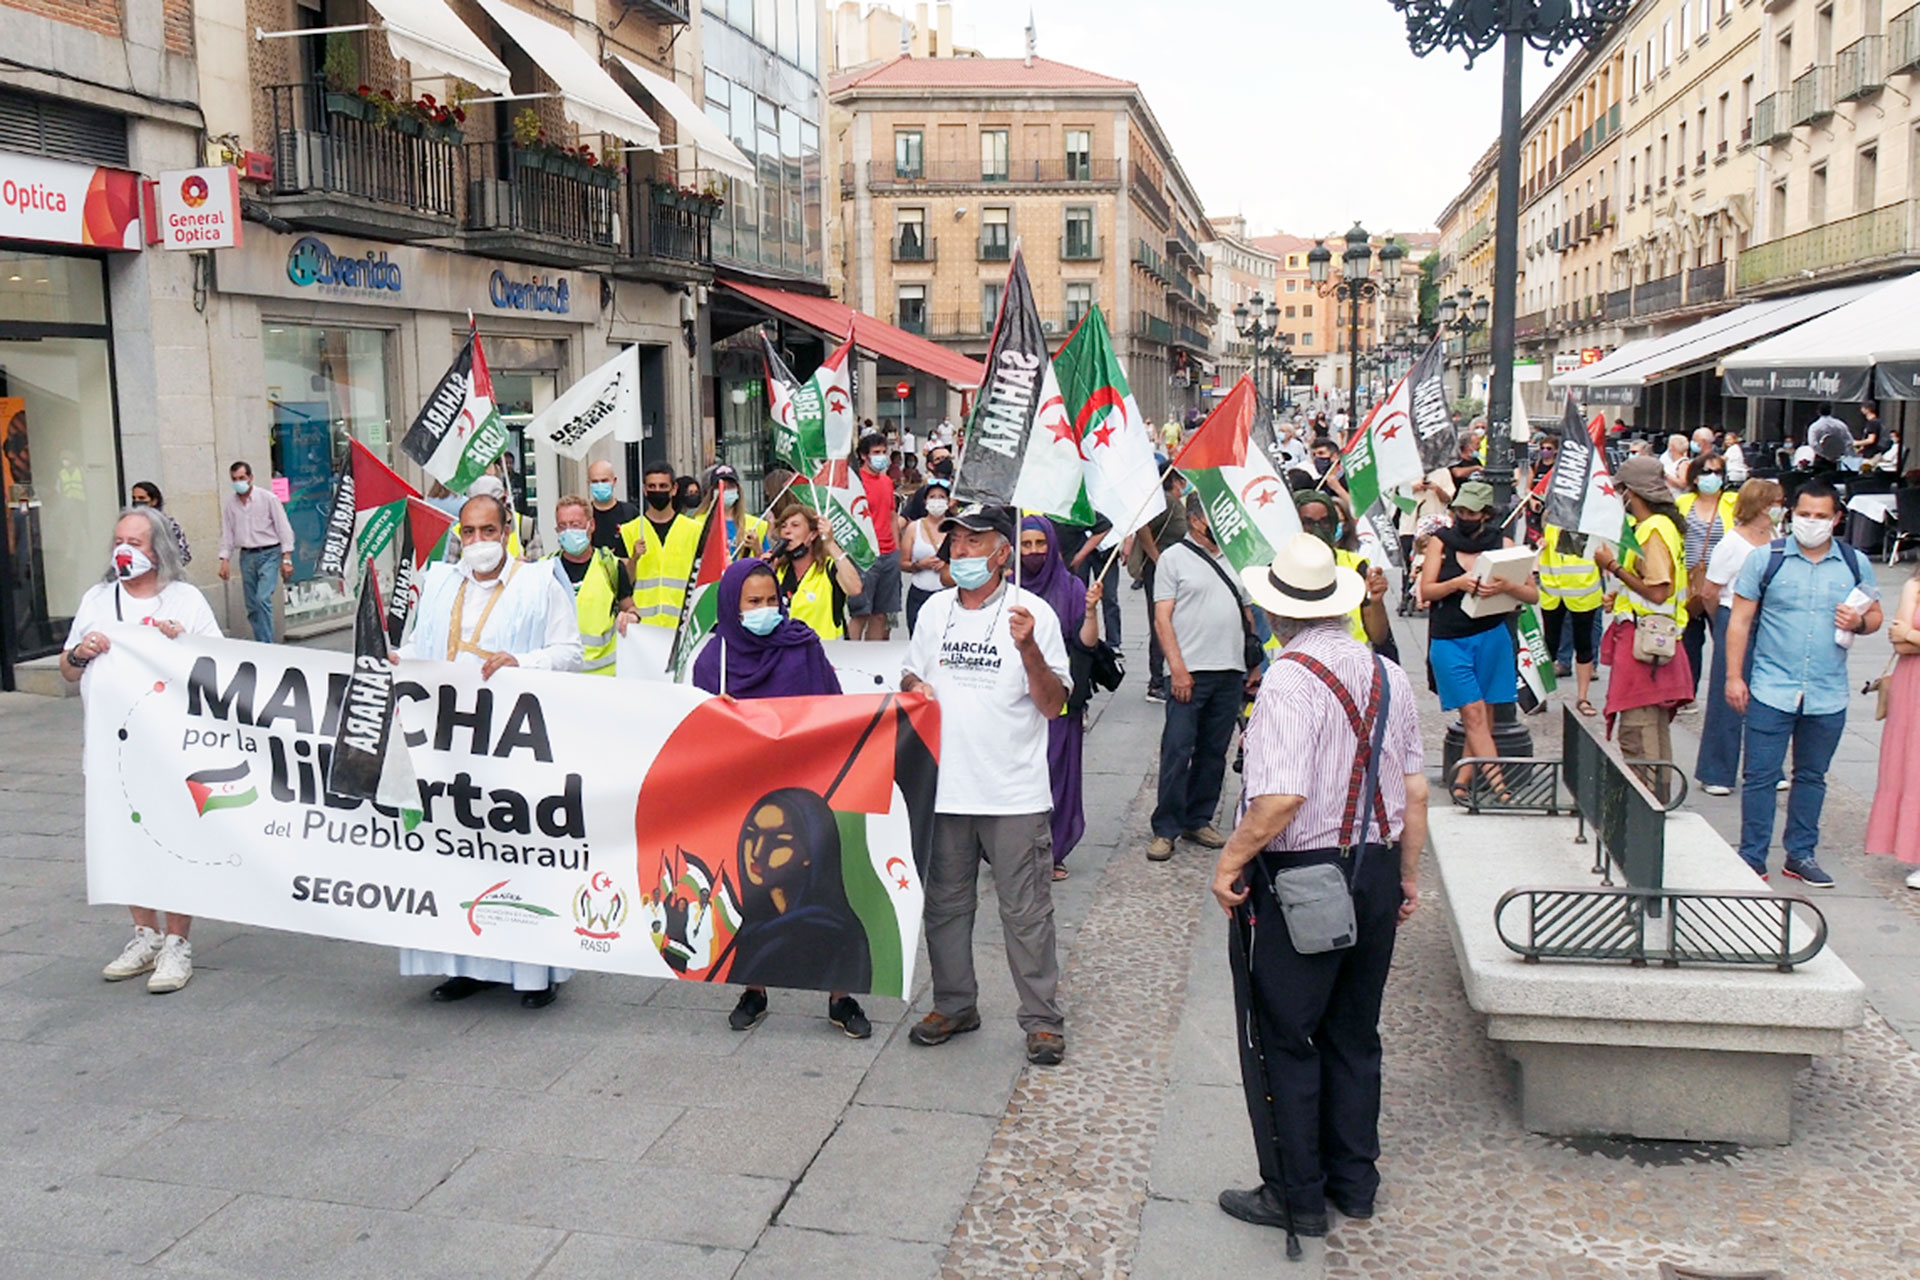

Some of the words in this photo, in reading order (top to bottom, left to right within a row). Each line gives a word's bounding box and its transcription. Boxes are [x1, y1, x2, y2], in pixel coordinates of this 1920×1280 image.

[3, 180, 66, 213] Optica
[169, 211, 225, 227] General
[175, 228, 221, 244] Optica
[1413, 376, 1450, 440] SAHARA
[1210, 490, 1249, 545] LIBRE
[940, 641, 998, 656] MARCHA
[950, 653, 1002, 668] libertad
[183, 728, 231, 751] por
[236, 728, 257, 753] la
[268, 736, 586, 839] lirtad
[264, 821, 291, 838] del
[302, 810, 424, 851] Pueblo
[436, 829, 589, 871] Saharaui
[291, 875, 439, 917] SEGOVIA
[580, 938, 611, 954] RASD
